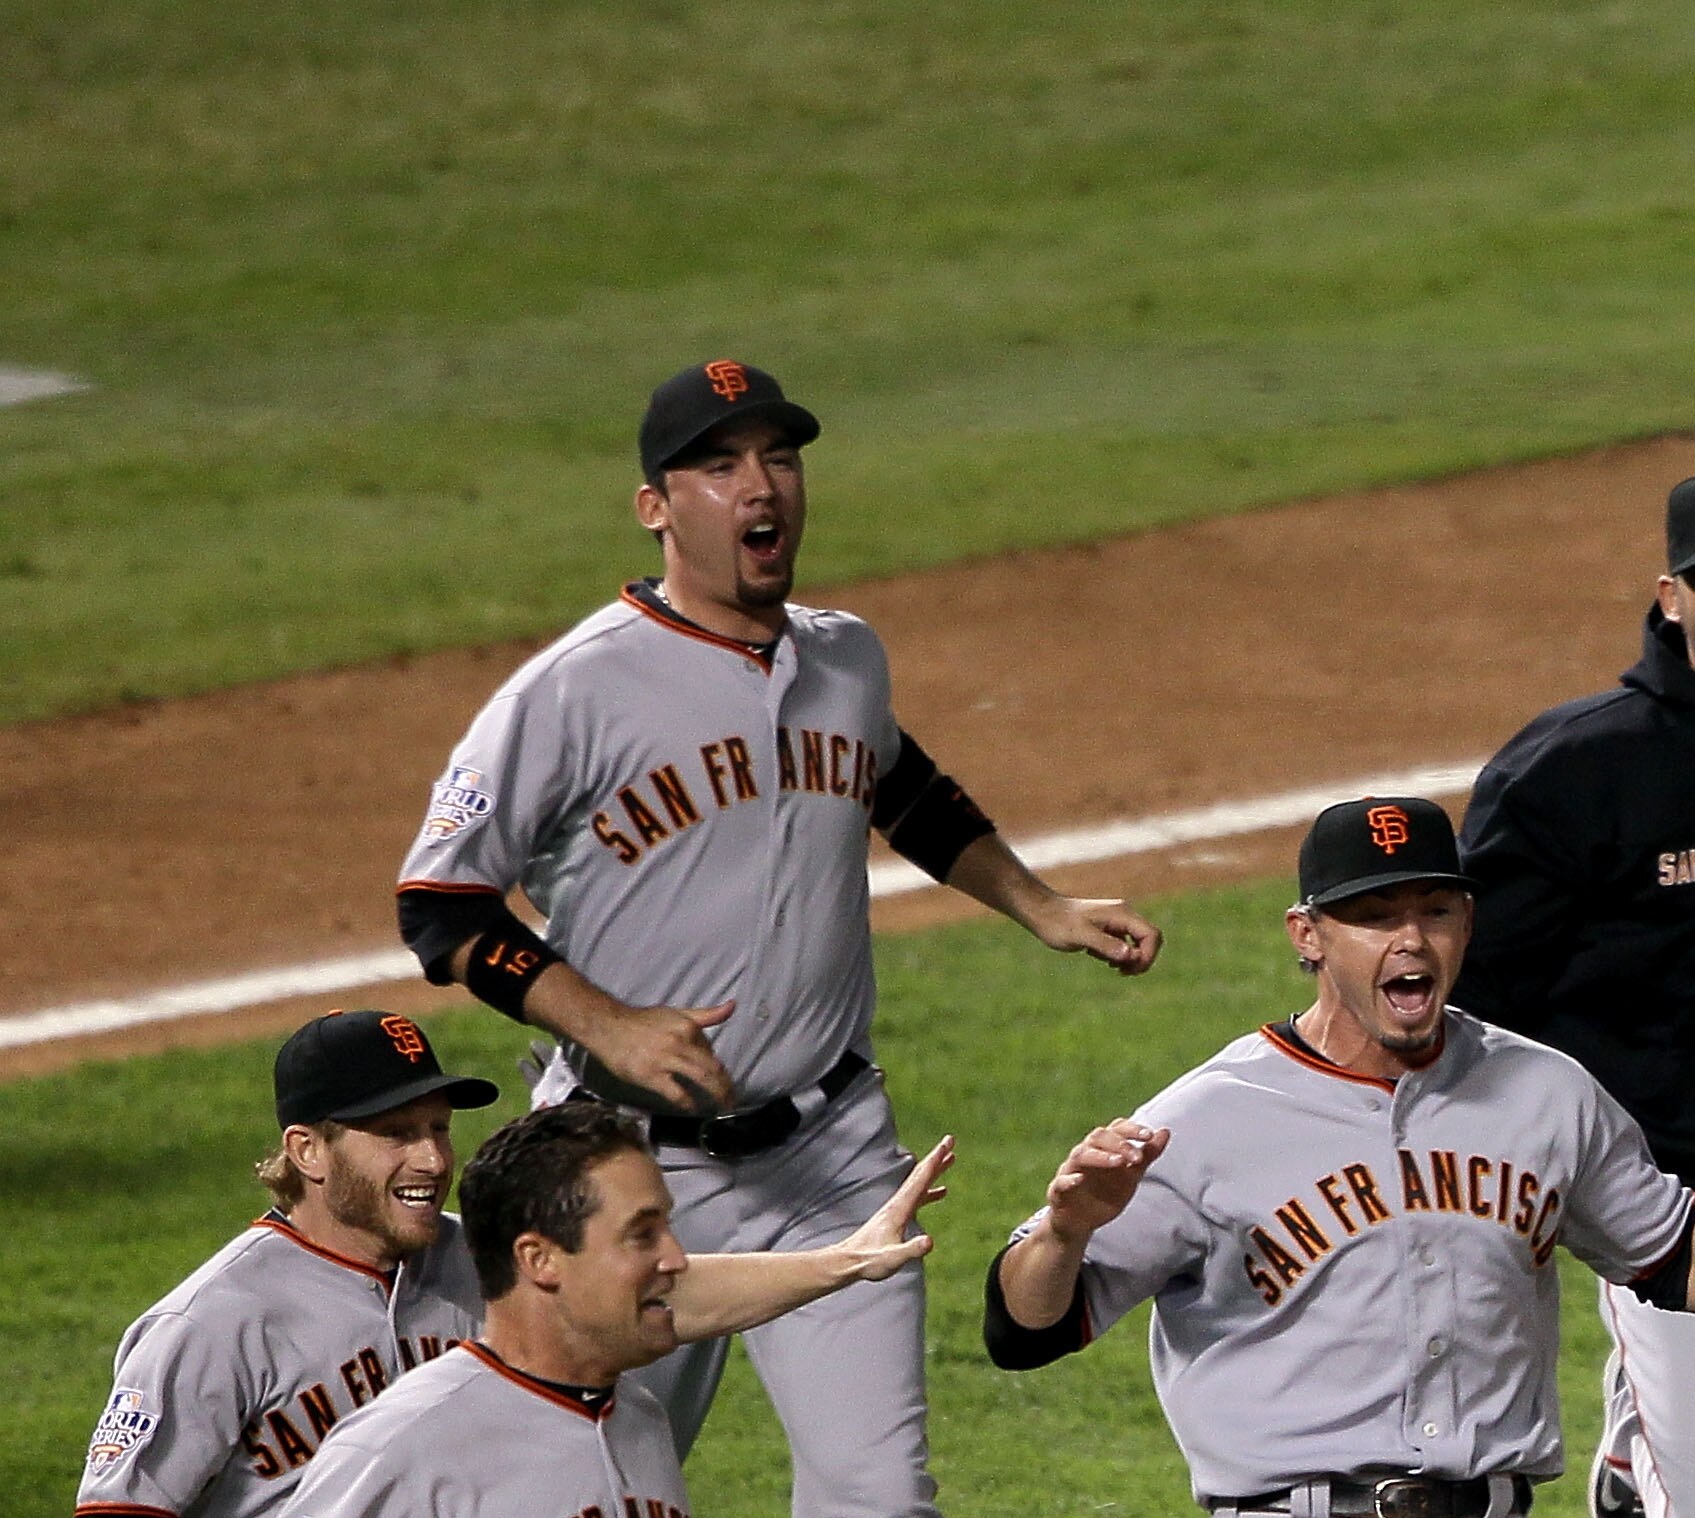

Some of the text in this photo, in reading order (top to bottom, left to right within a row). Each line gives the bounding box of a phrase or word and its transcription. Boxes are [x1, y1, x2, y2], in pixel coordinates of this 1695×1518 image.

[704, 357, 749, 402] SF
[591, 763, 703, 866] SAN
[1366, 804, 1410, 854] SF
[378, 1013, 426, 1064] SF
[1242, 1197, 1335, 1307] SAN
[100, 1410, 157, 1436] ORLD
[241, 1382, 342, 1481] SAN
